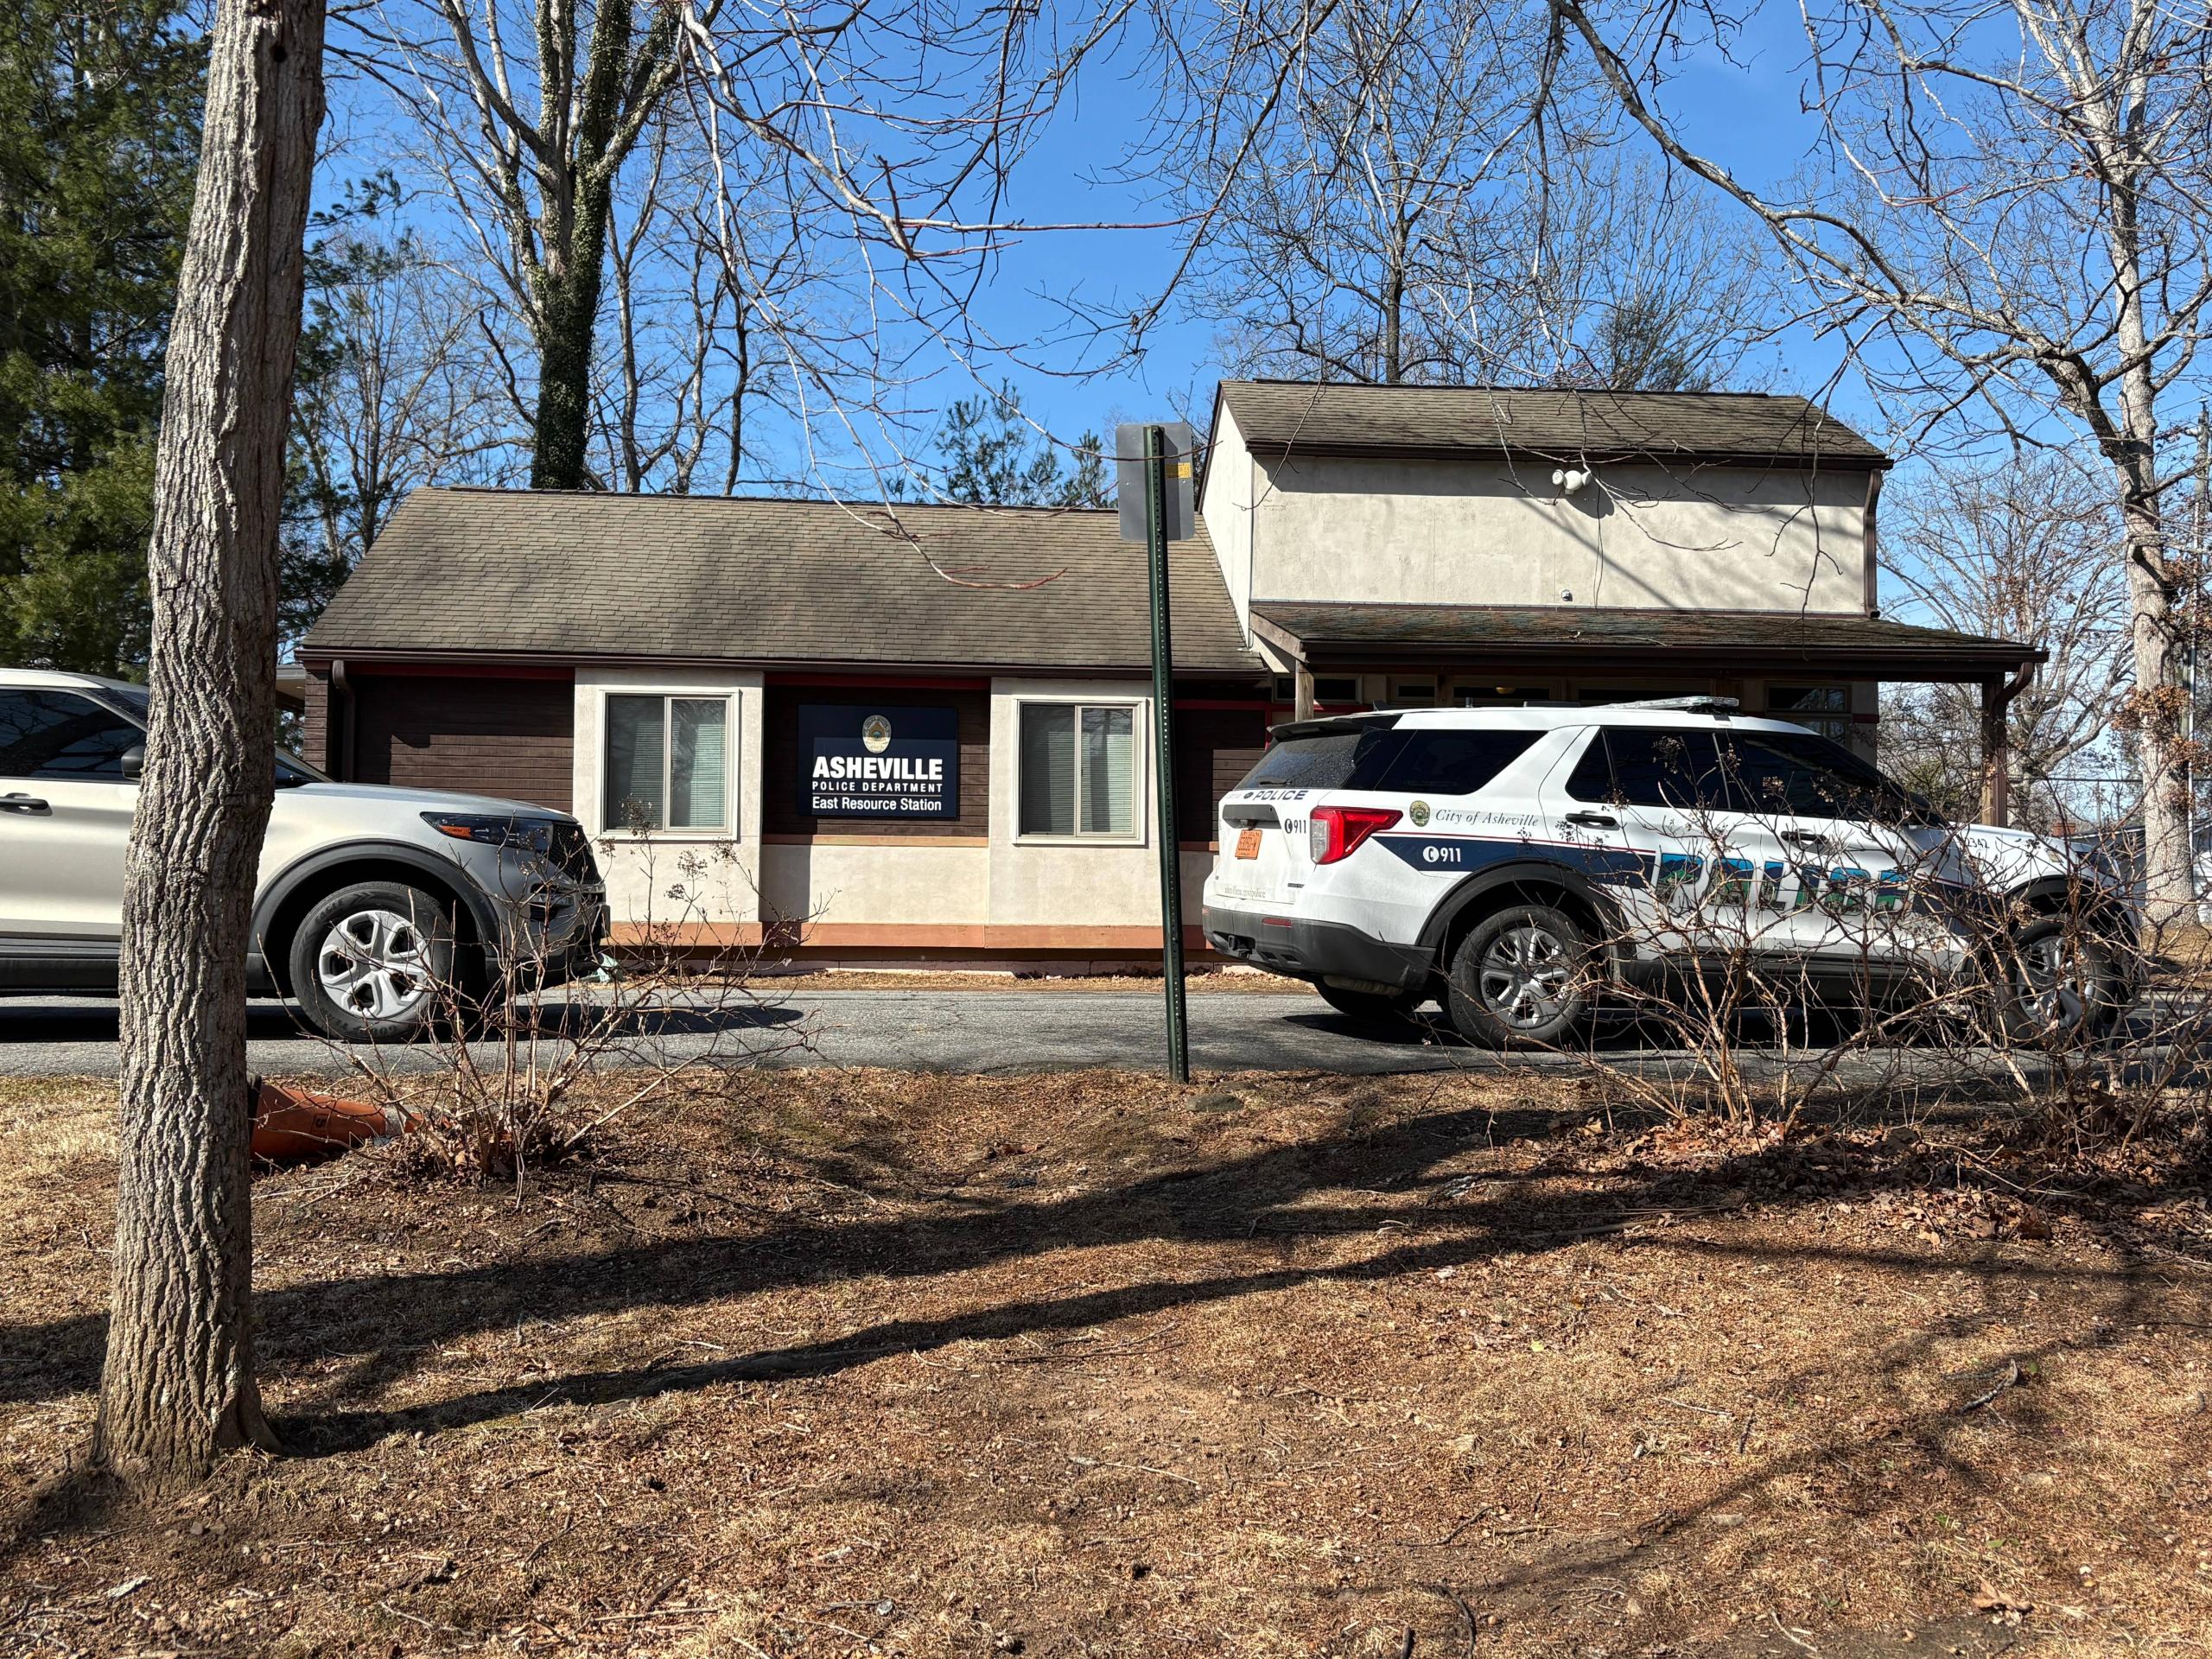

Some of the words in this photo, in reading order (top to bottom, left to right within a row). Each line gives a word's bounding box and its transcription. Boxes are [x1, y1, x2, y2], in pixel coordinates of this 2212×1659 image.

[812, 756, 943, 780] ASHEVILLE
[812, 781, 855, 791] POLICE
[862, 782, 943, 793] DEPARTMENT
[1252, 790, 1309, 801] POLICE
[812, 797, 838, 809] East
[842, 798, 897, 810] Resource
[900, 798, 942, 810] Station
[1435, 809, 1463, 824] City
[1465, 811, 1481, 825] of
[1482, 812, 1539, 827] Asheville
[1294, 819, 1306, 834] 911
[1440, 847, 1461, 862] 911
